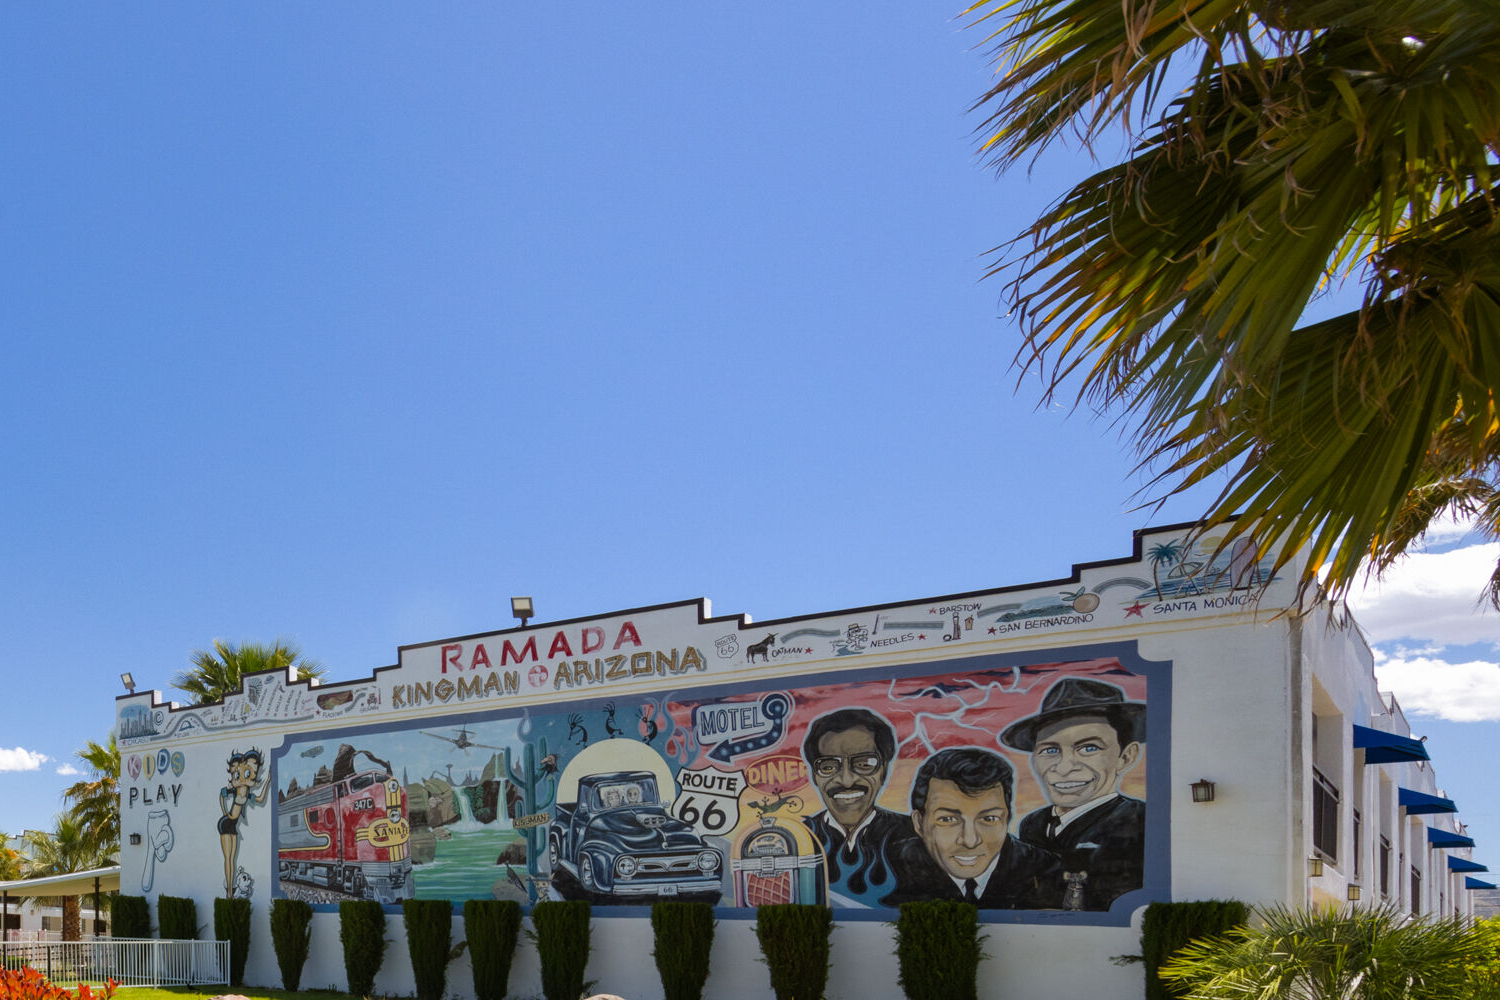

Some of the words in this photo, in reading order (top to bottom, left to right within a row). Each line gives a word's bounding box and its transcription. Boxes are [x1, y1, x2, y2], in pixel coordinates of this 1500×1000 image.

[939, 603, 982, 615] BARSTOW
[1153, 601, 1197, 614] SANTA
[1203, 593, 1258, 609] MONICA
[999, 622, 1021, 634] SAN
[1024, 613, 1094, 630] BERNARDINO
[441, 620, 643, 674] RAMADA
[720, 645, 735, 656] 66
[870, 632, 915, 649] NEEDLES
[771, 647, 803, 658] OATMAN
[391, 670, 520, 708] KINGMAN
[553, 646, 703, 687] ARIZONA
[700, 706, 765, 737] MOTEL
[129, 751, 182, 777] KIDS
[682, 773, 738, 791] ROUTE
[129, 784, 183, 807] PLAY
[354, 798, 373, 810] 347C
[514, 813, 548, 826] KINGMAN
[678, 796, 727, 831] 66
